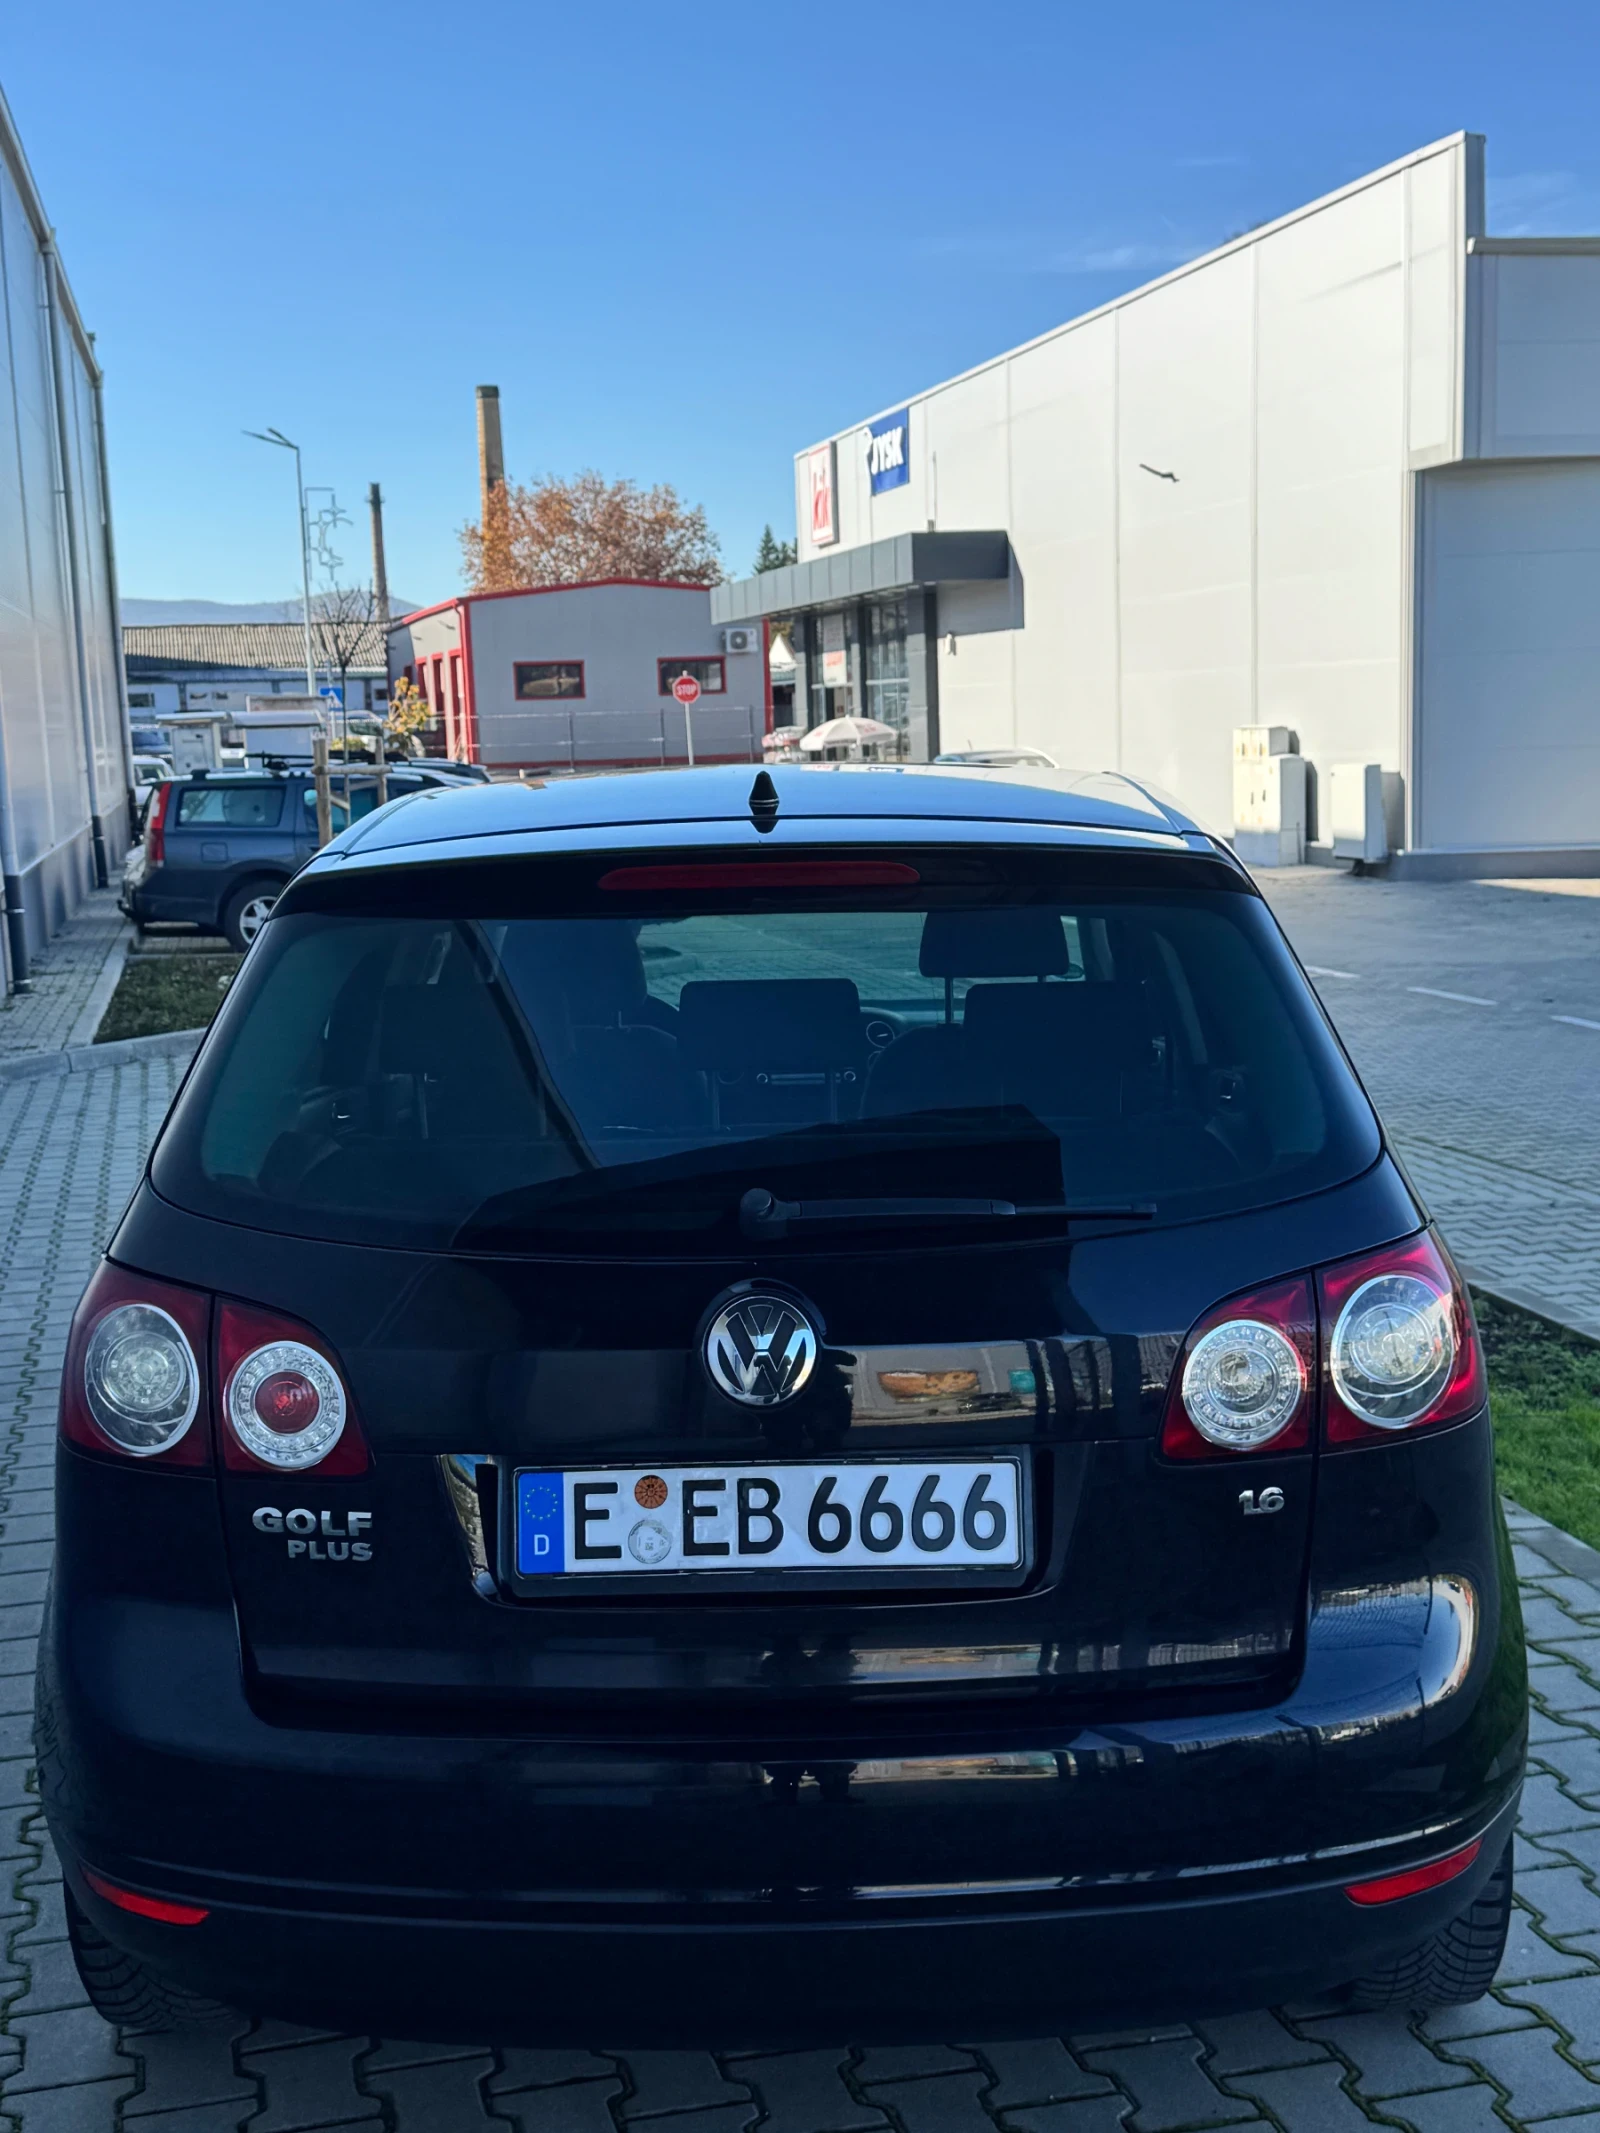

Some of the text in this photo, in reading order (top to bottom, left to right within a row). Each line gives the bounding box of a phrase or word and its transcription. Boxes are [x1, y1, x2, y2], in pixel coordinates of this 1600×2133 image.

[871, 426, 904, 475] JYSK
[676, 683, 697, 697] STOP
[252, 1506, 373, 1537] GOLF
[534, 1534, 550, 1556] D
[573, 1481, 622, 1560] E
[682, 1477, 784, 1557] EB
[807, 1473, 1007, 1554] 6666
[287, 1539, 373, 1562] PLUS
